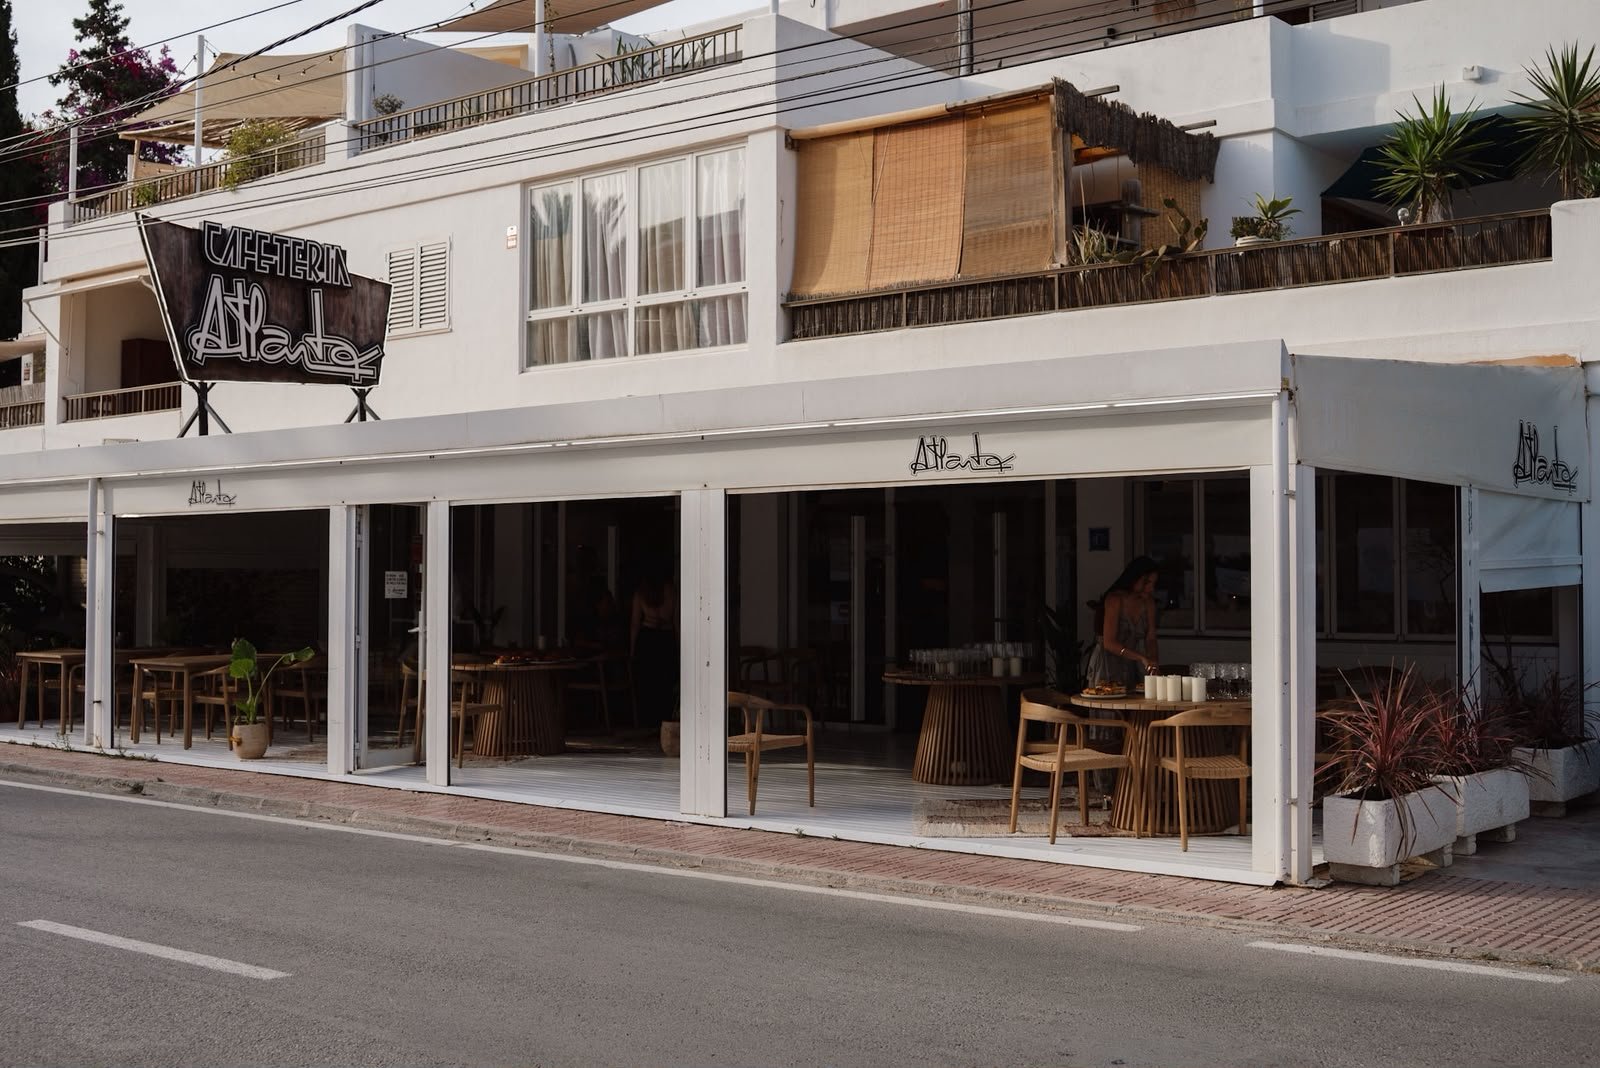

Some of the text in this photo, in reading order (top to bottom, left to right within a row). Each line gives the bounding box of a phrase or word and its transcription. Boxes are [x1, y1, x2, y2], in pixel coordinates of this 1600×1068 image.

[203, 220, 352, 287] CAFETERIA
[186, 274, 383, 383] Atlanta
[910, 432, 1016, 474] Atlanta
[1513, 419, 1578, 495] Atlanta
